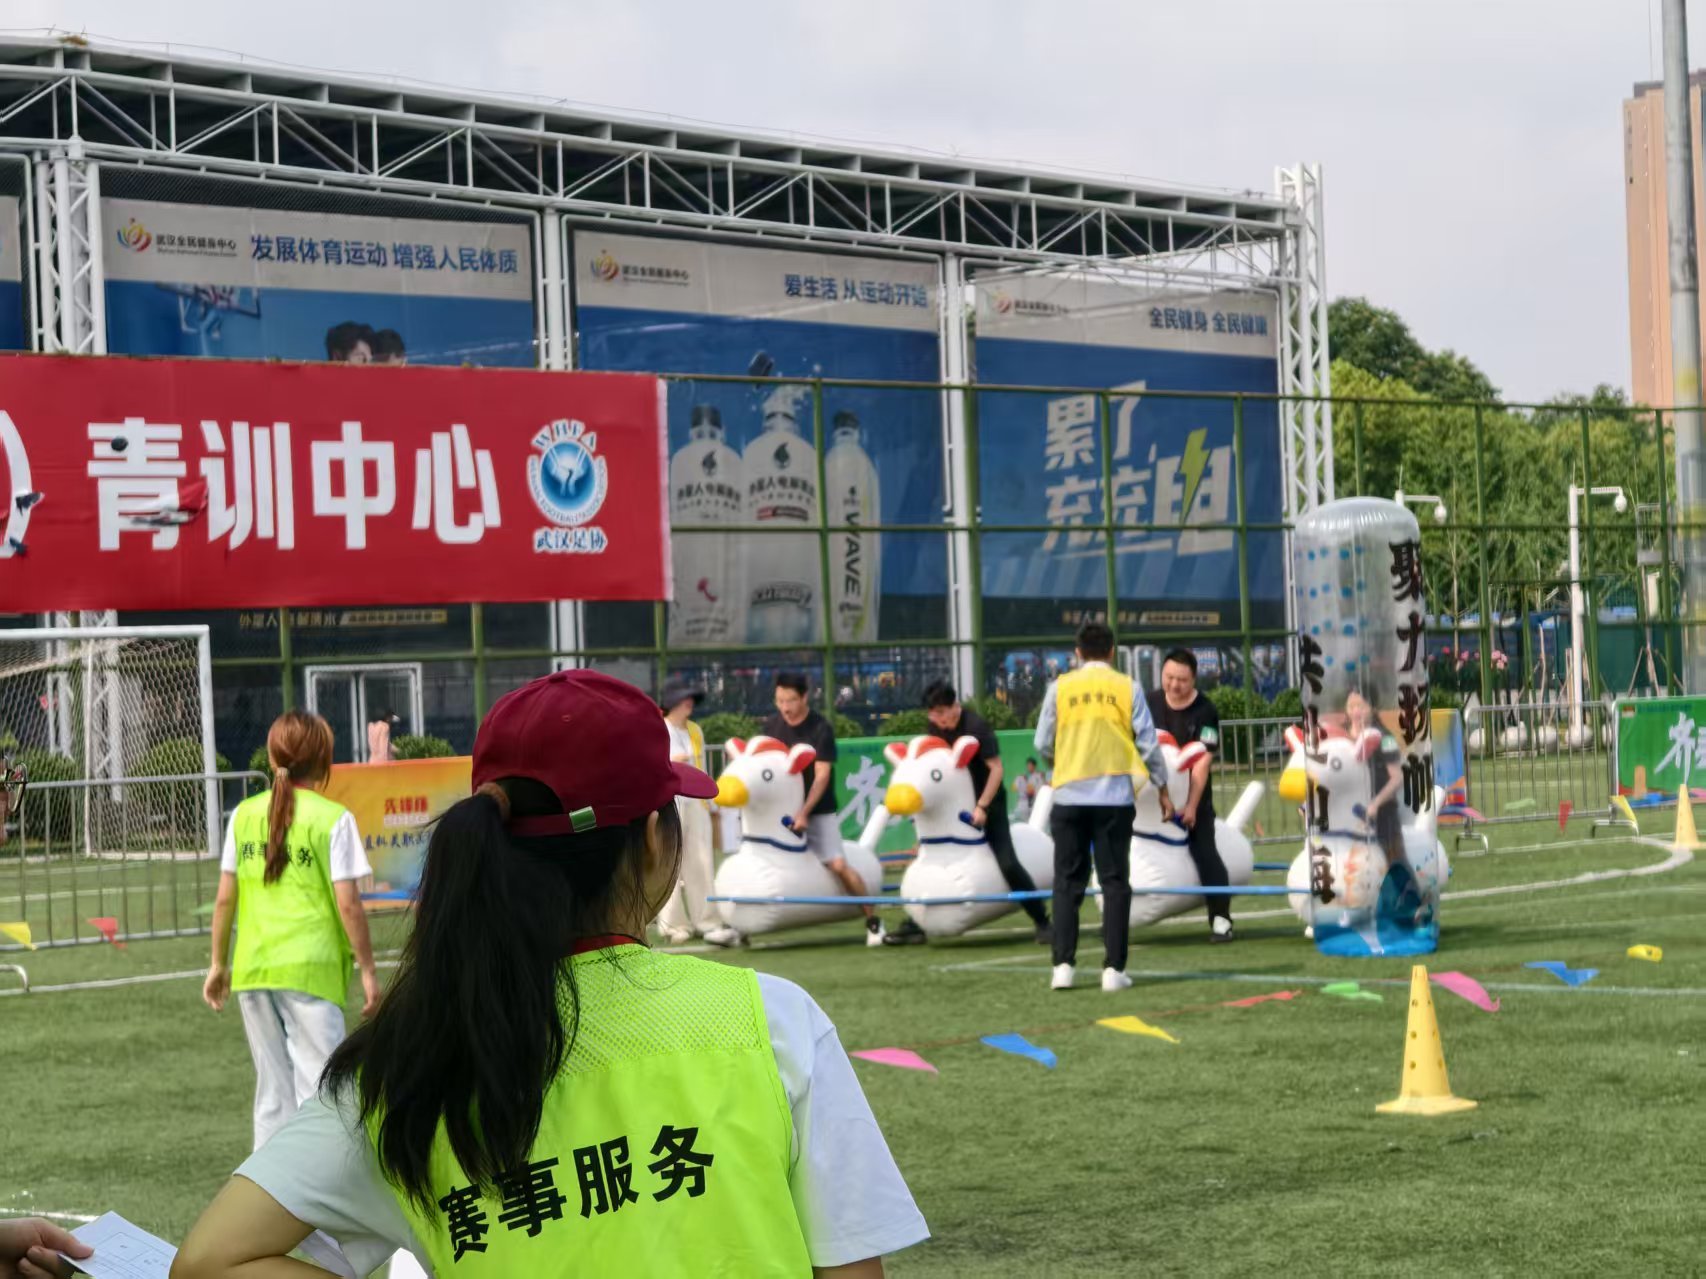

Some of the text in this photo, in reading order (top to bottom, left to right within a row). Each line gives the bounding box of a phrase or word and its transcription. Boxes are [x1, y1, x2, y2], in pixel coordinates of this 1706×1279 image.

[250, 233, 518, 274] 发展体育运动 增强人民体质
[784, 274, 928, 308] 爱生活 从运动开始
[87, 417, 501, 551] 青训中心
[438, 1125, 714, 1264] 赛事服务
